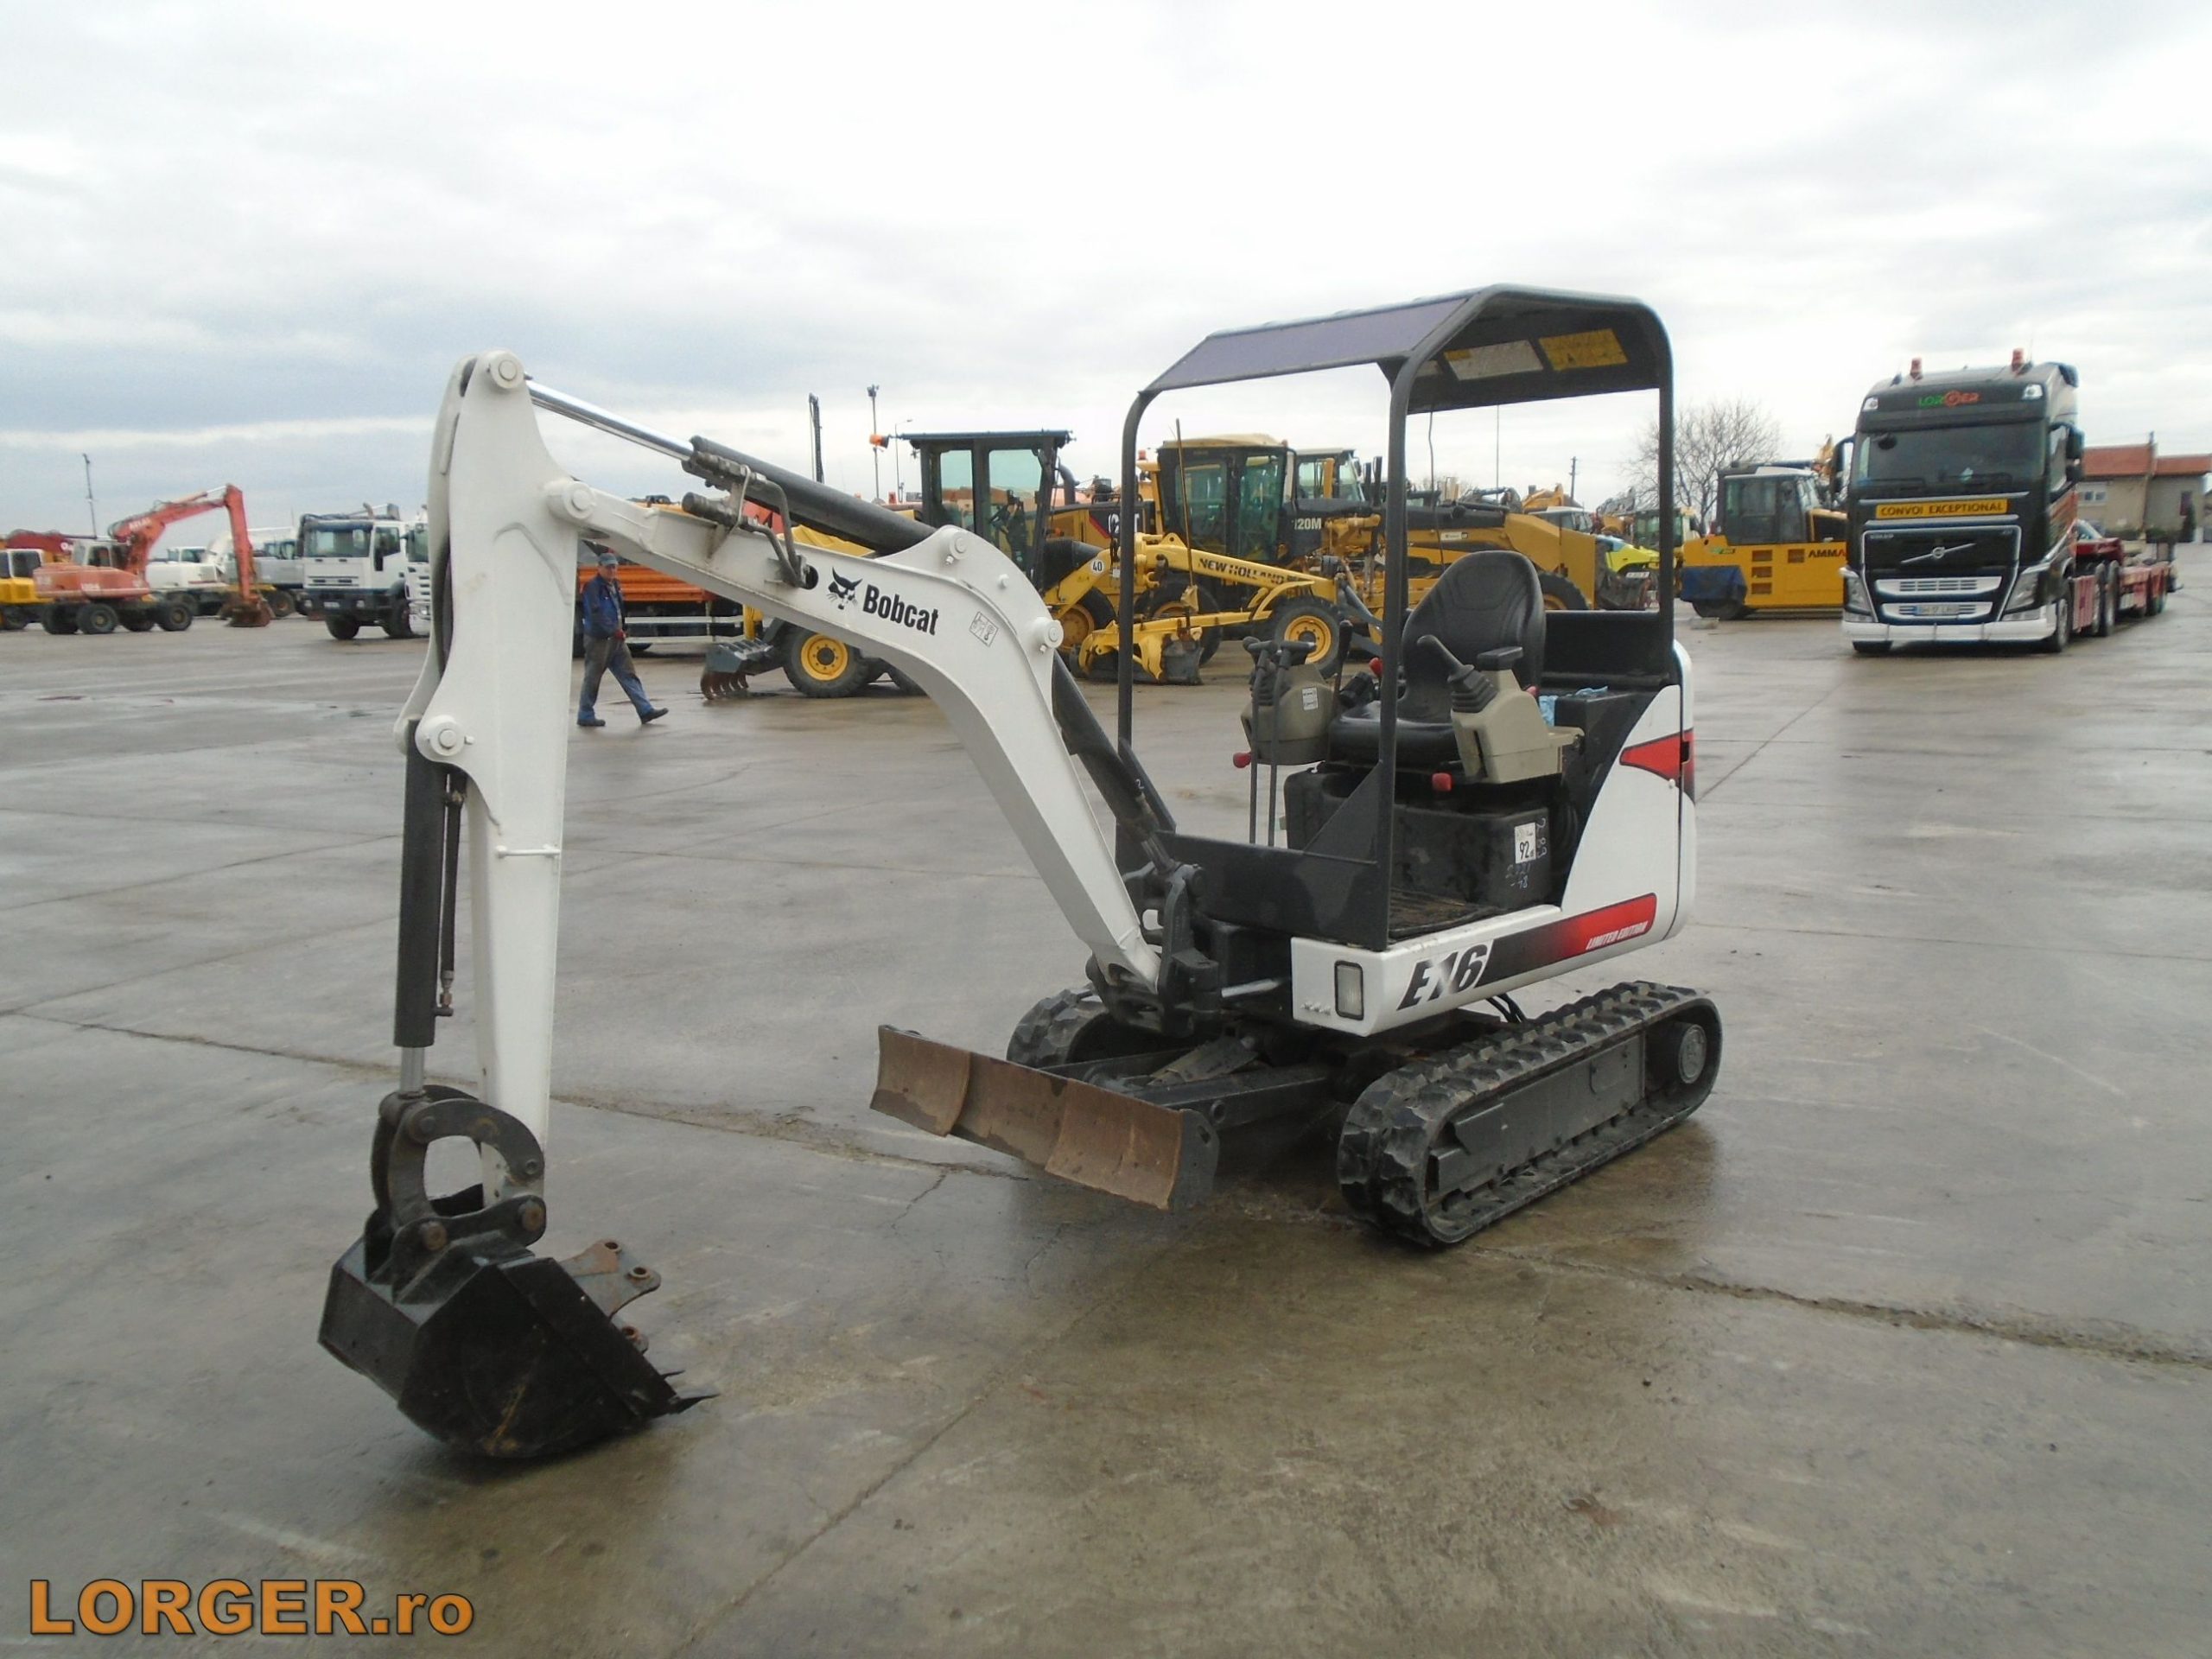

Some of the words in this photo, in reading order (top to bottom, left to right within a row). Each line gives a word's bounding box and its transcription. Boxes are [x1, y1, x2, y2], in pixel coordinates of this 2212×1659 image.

[1880, 505, 1923, 516] CONVOI
[1929, 502, 2004, 514] EXCEPTIONAL
[1108, 513, 1141, 533] CT
[1291, 518, 1322, 531] 120M
[1092, 561, 1103, 571] 40
[1199, 558, 1227, 572] NEW
[1229, 563, 1285, 585] HOLLAND
[862, 583, 939, 636] Bobcat
[1519, 840, 1530, 861] 92
[1585, 930, 1619, 950] LIMITED
[1616, 920, 1649, 940] EDITION
[1396, 944, 1488, 1012] E16
